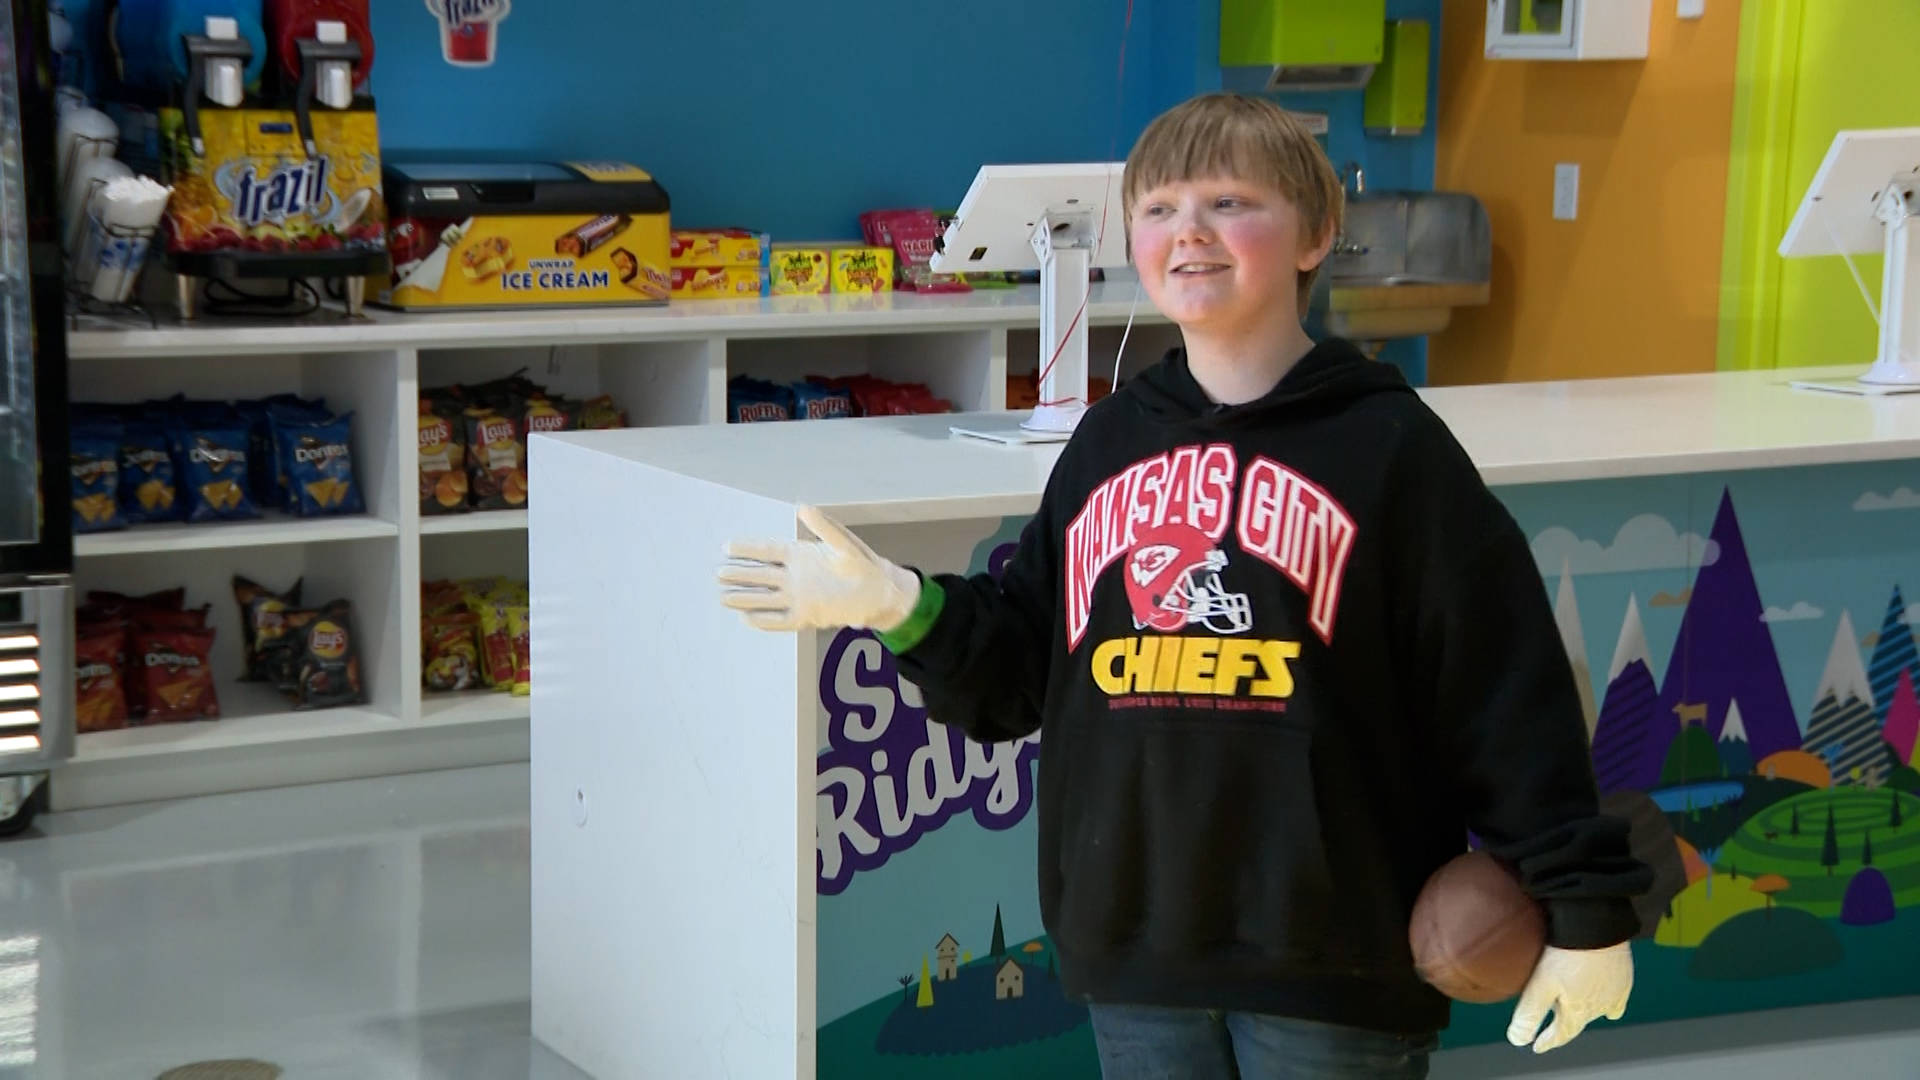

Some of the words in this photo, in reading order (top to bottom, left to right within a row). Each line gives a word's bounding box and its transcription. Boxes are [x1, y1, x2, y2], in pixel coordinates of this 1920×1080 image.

[237, 157, 326, 223] frazil
[502, 273, 533, 289] ICE
[539, 272, 608, 289] CREAM
[529, 259, 574, 269] UNWRAP
[1065, 444, 1238, 655] KANSAS
[1235, 455, 1358, 647] CITY
[1092, 637, 1301, 698] CHIEFS
